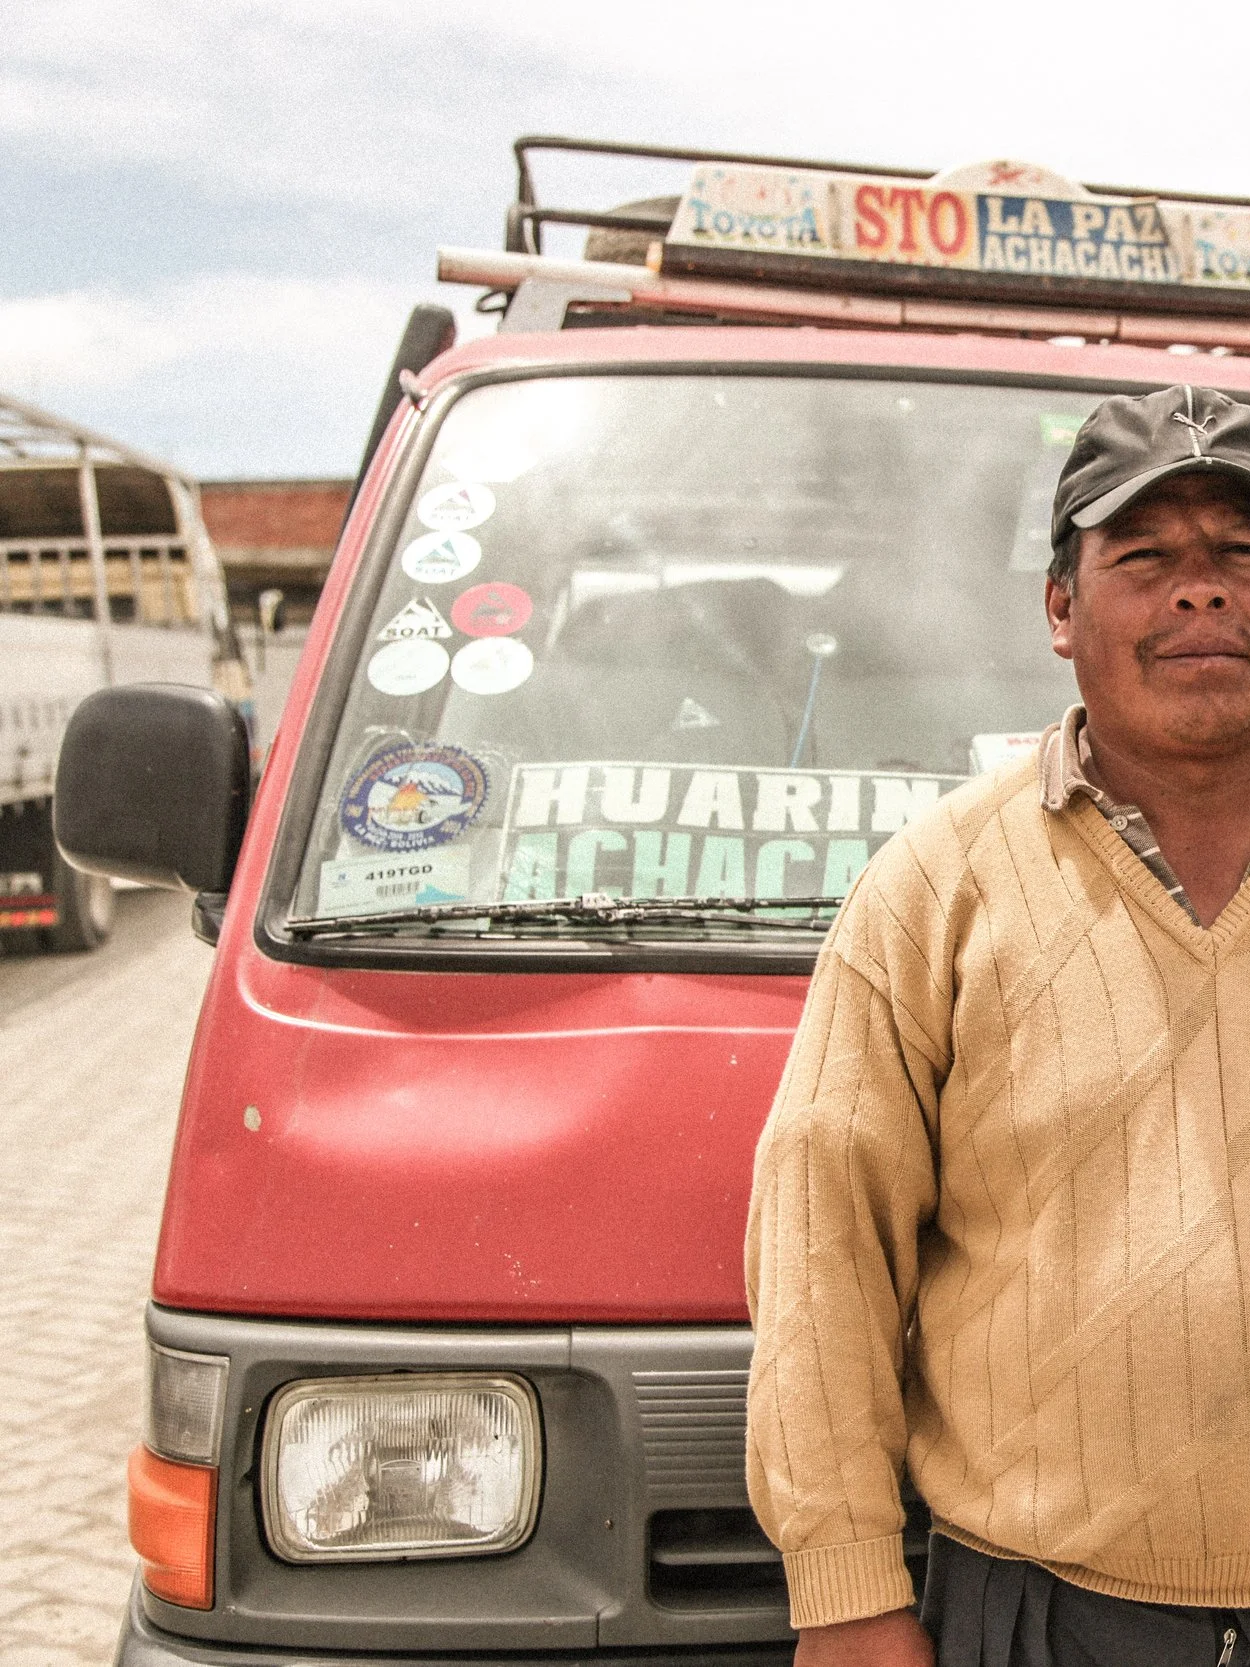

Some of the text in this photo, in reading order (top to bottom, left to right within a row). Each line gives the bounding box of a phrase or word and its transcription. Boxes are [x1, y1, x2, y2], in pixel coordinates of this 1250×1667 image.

[855, 184, 966, 255] STO
[985, 196, 1166, 246] LA PAZ
[386, 626, 444, 638] SOAT
[365, 864, 433, 881] 419TGD
